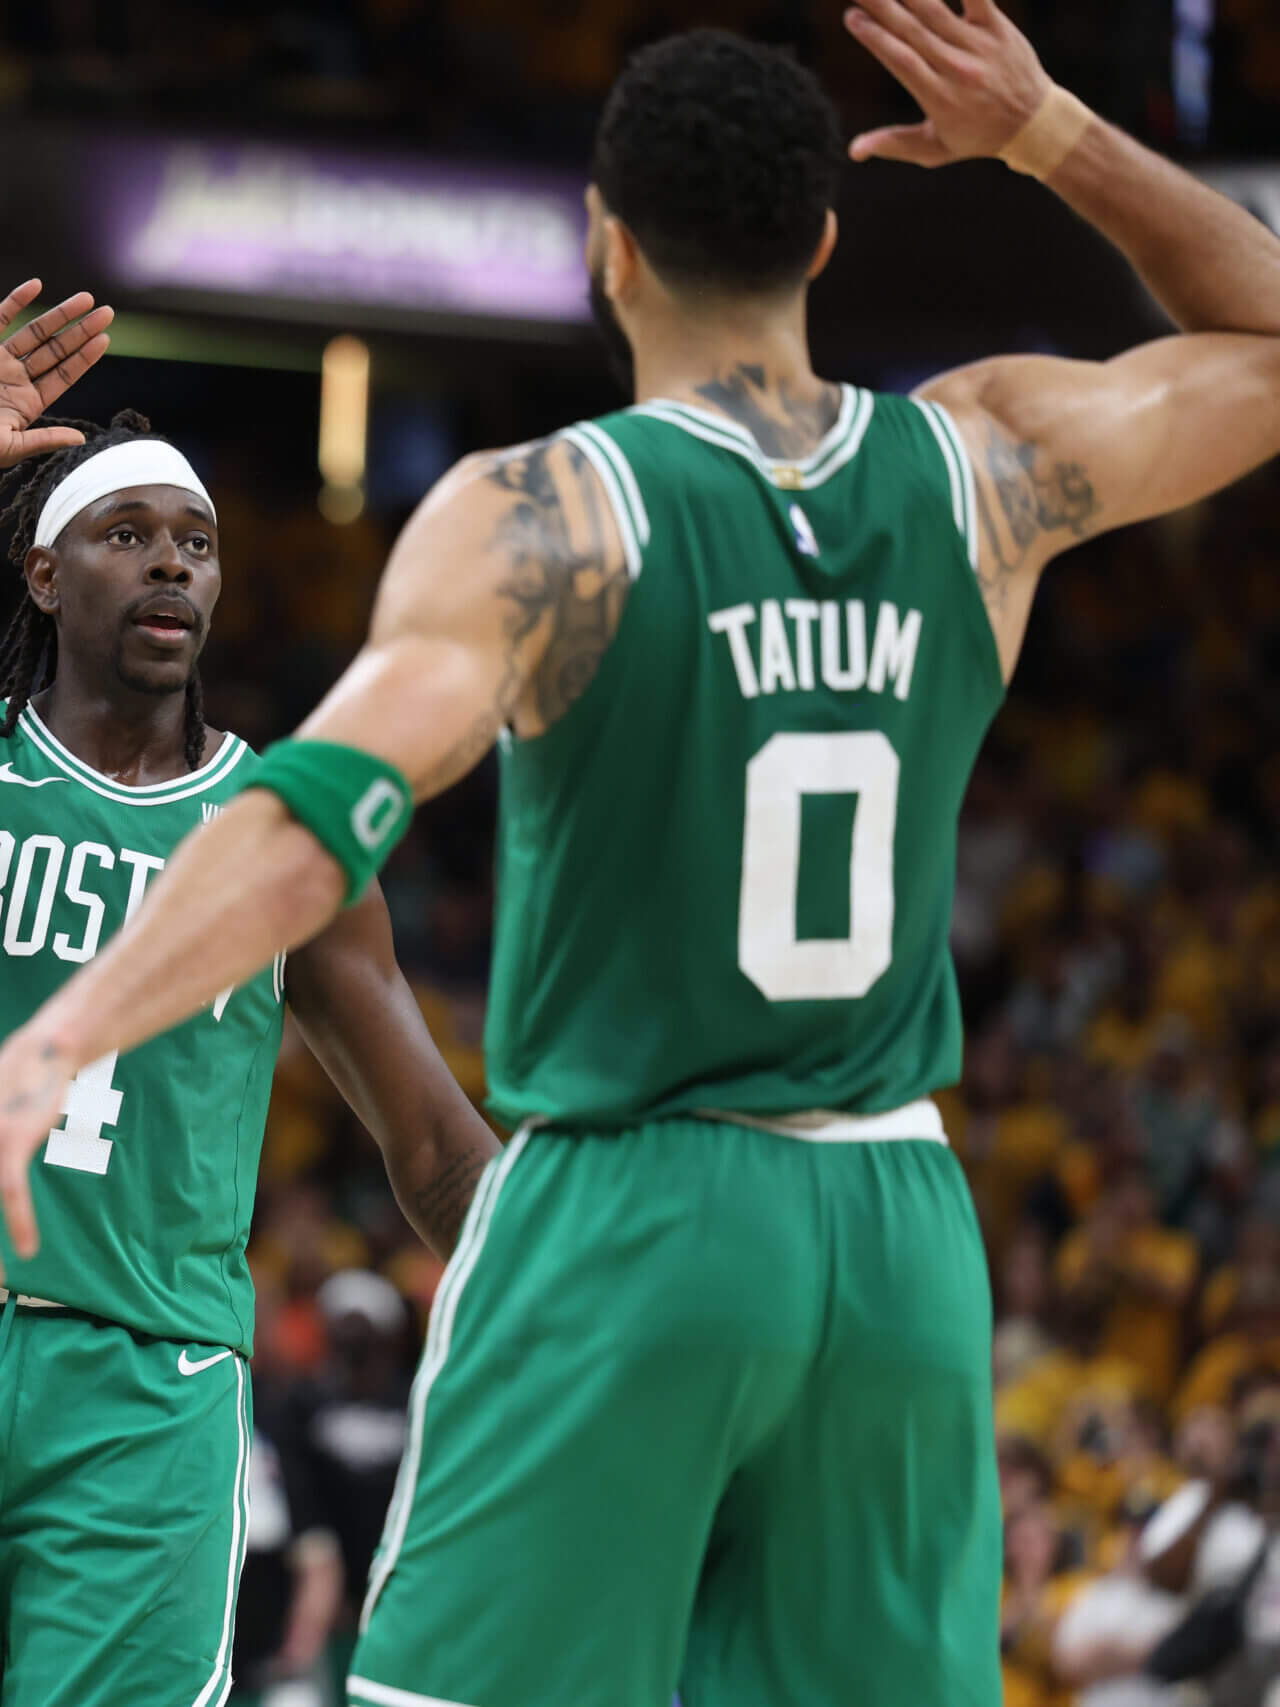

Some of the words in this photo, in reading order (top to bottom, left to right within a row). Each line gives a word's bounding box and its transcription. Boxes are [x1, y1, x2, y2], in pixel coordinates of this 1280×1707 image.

[708, 599, 921, 700] TATUM
[351, 777, 405, 852] 0
[738, 731, 900, 1001] 0
